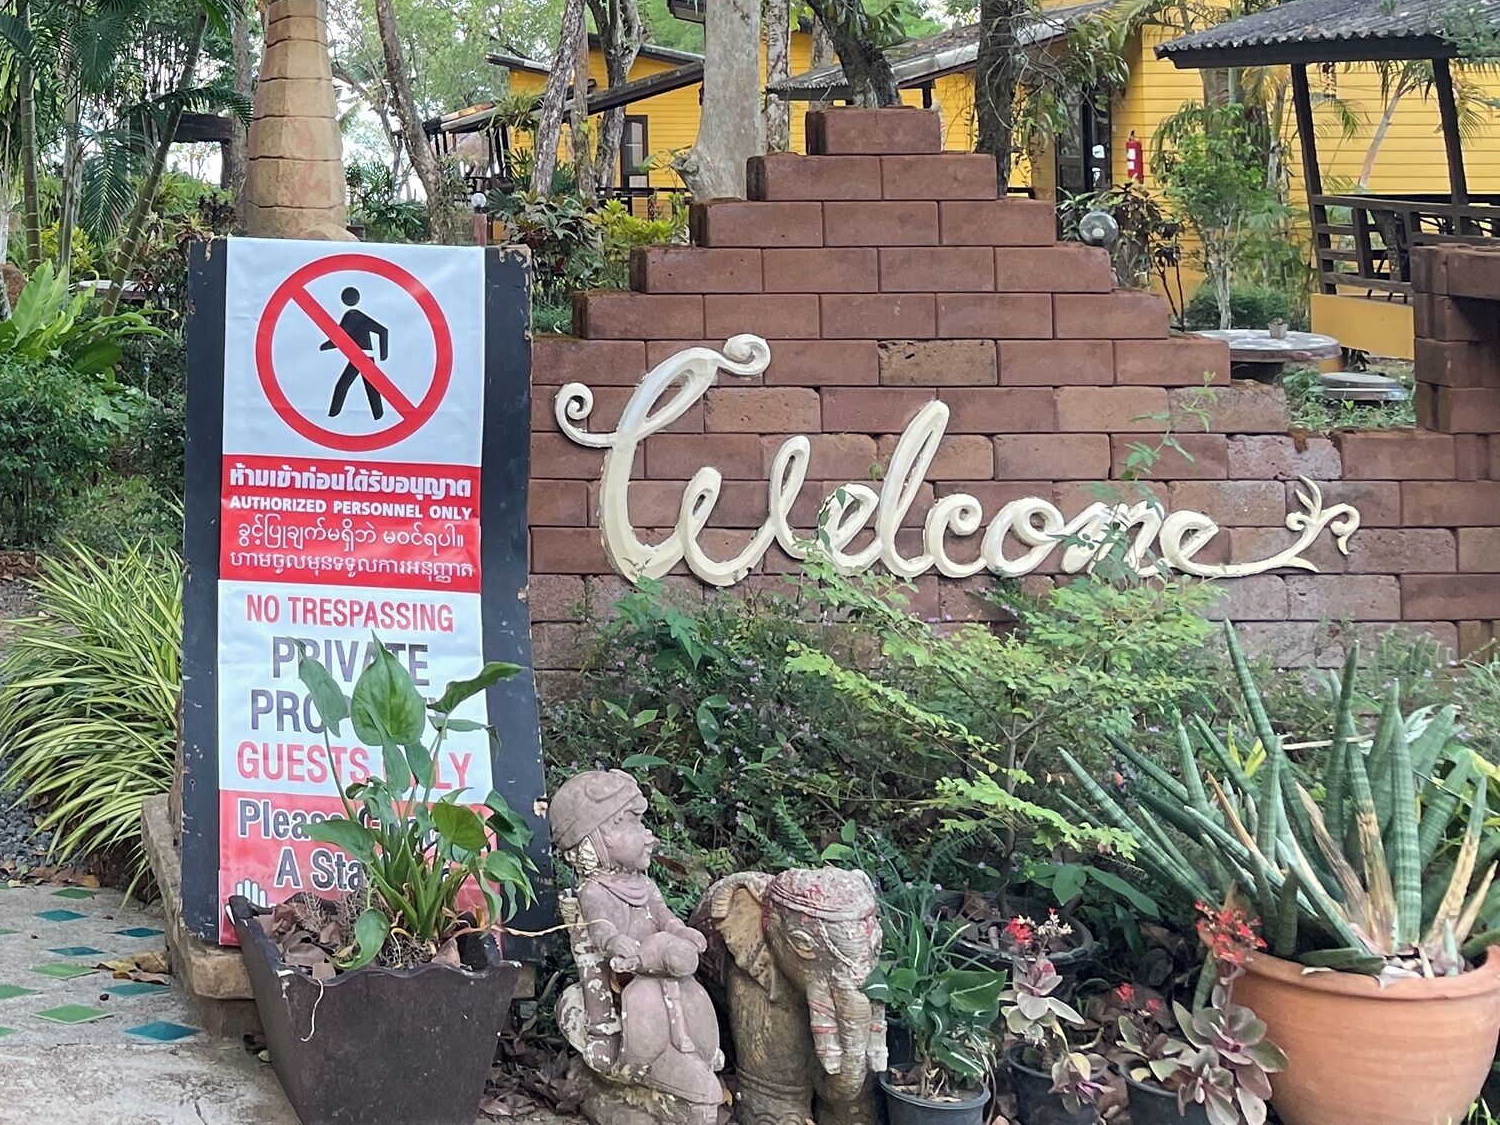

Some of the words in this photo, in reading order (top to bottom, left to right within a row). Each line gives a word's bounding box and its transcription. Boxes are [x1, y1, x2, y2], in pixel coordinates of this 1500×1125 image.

[555, 334, 1358, 587] Welcome
[229, 463, 472, 501] ห้ามเข้าก่อนได้รับอนุญาต
[229, 495, 327, 513] AUTHORIZED
[333, 500, 423, 519] PERSONNEL
[429, 506, 473, 521] ONLY
[246, 594, 280, 623] NO
[288, 596, 454, 633] TRESPASSING
[237, 740, 371, 784] GUESTS
[382, 751, 473, 790] LY
[274, 846, 302, 888] A
